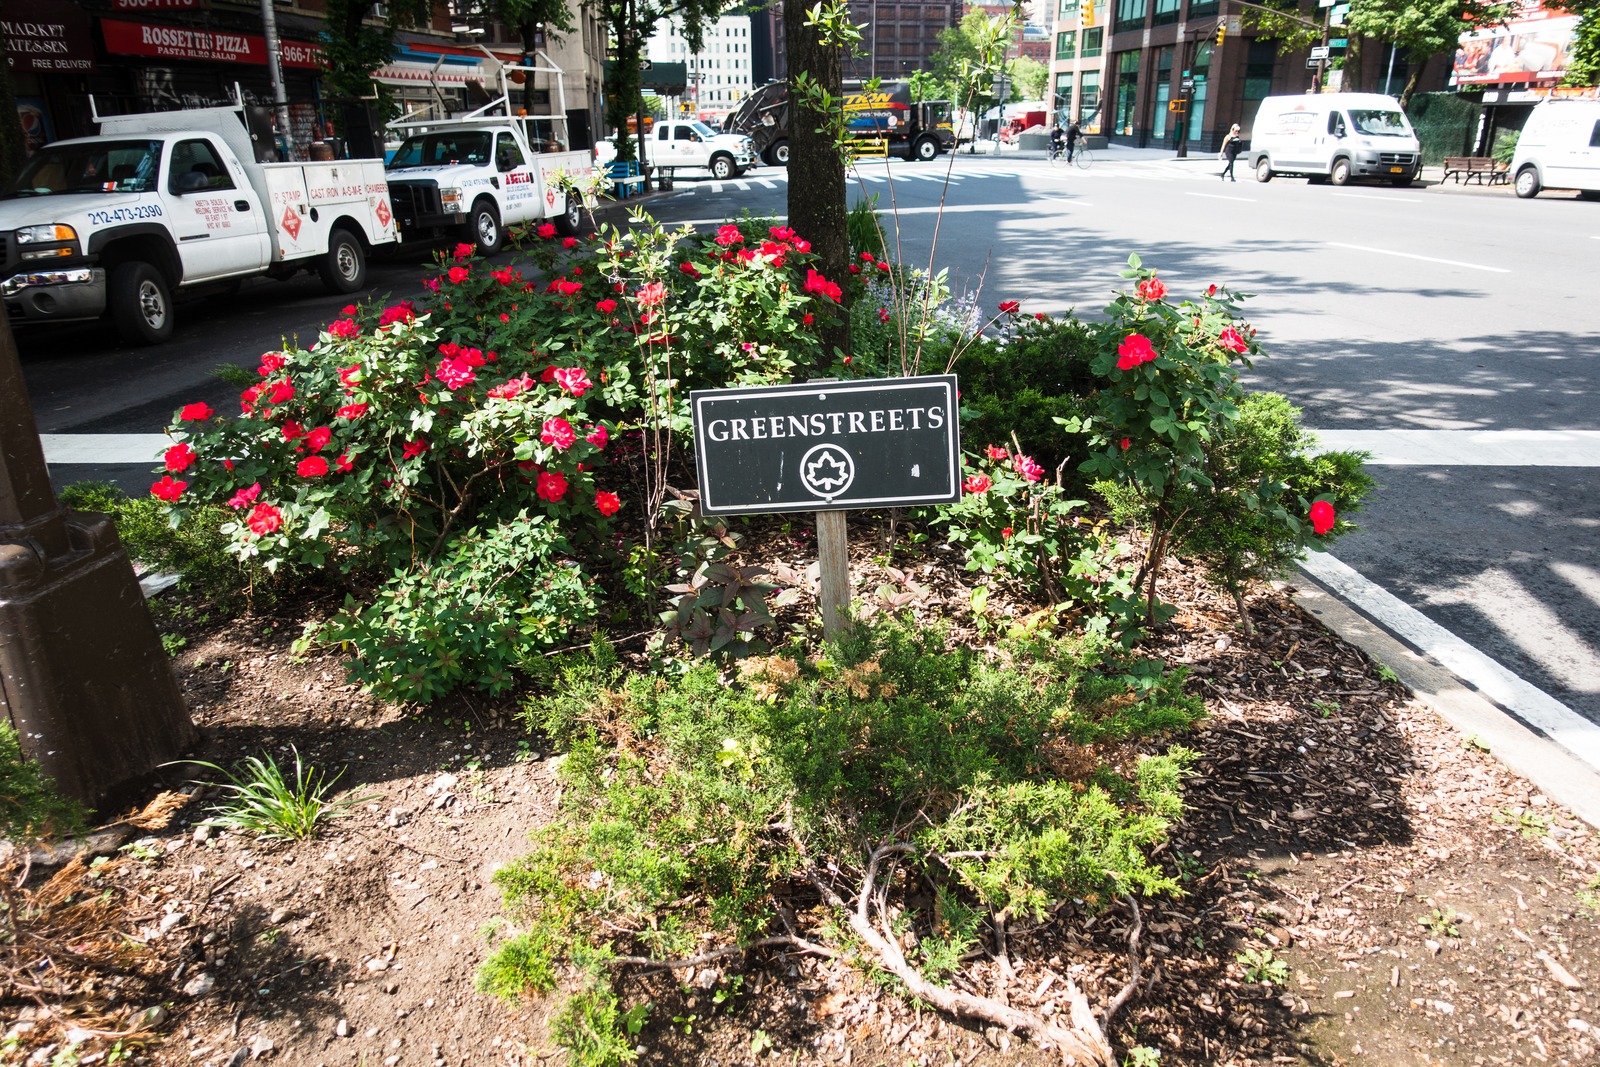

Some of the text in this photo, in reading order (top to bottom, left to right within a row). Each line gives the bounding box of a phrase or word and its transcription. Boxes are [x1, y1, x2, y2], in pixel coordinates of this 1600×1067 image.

[1, 21, 65, 37] MARKET
[4, 38, 69, 53] ATESSEN
[215, 35, 250, 54] PIZZA
[157, 46, 186, 56] PASTA
[211, 51, 237, 60] SALAD
[32, 58, 53, 68] FREE
[55, 59, 92, 69] DELIVERY
[311, 188, 324, 199] CAST
[326, 187, 339, 198] IRON
[366, 183, 389, 193] CHAMBERS
[282, 190, 302, 202] STAMP
[88, 204, 163, 225] 212-473-2390
[707, 405, 945, 442] GREENSTREETS
